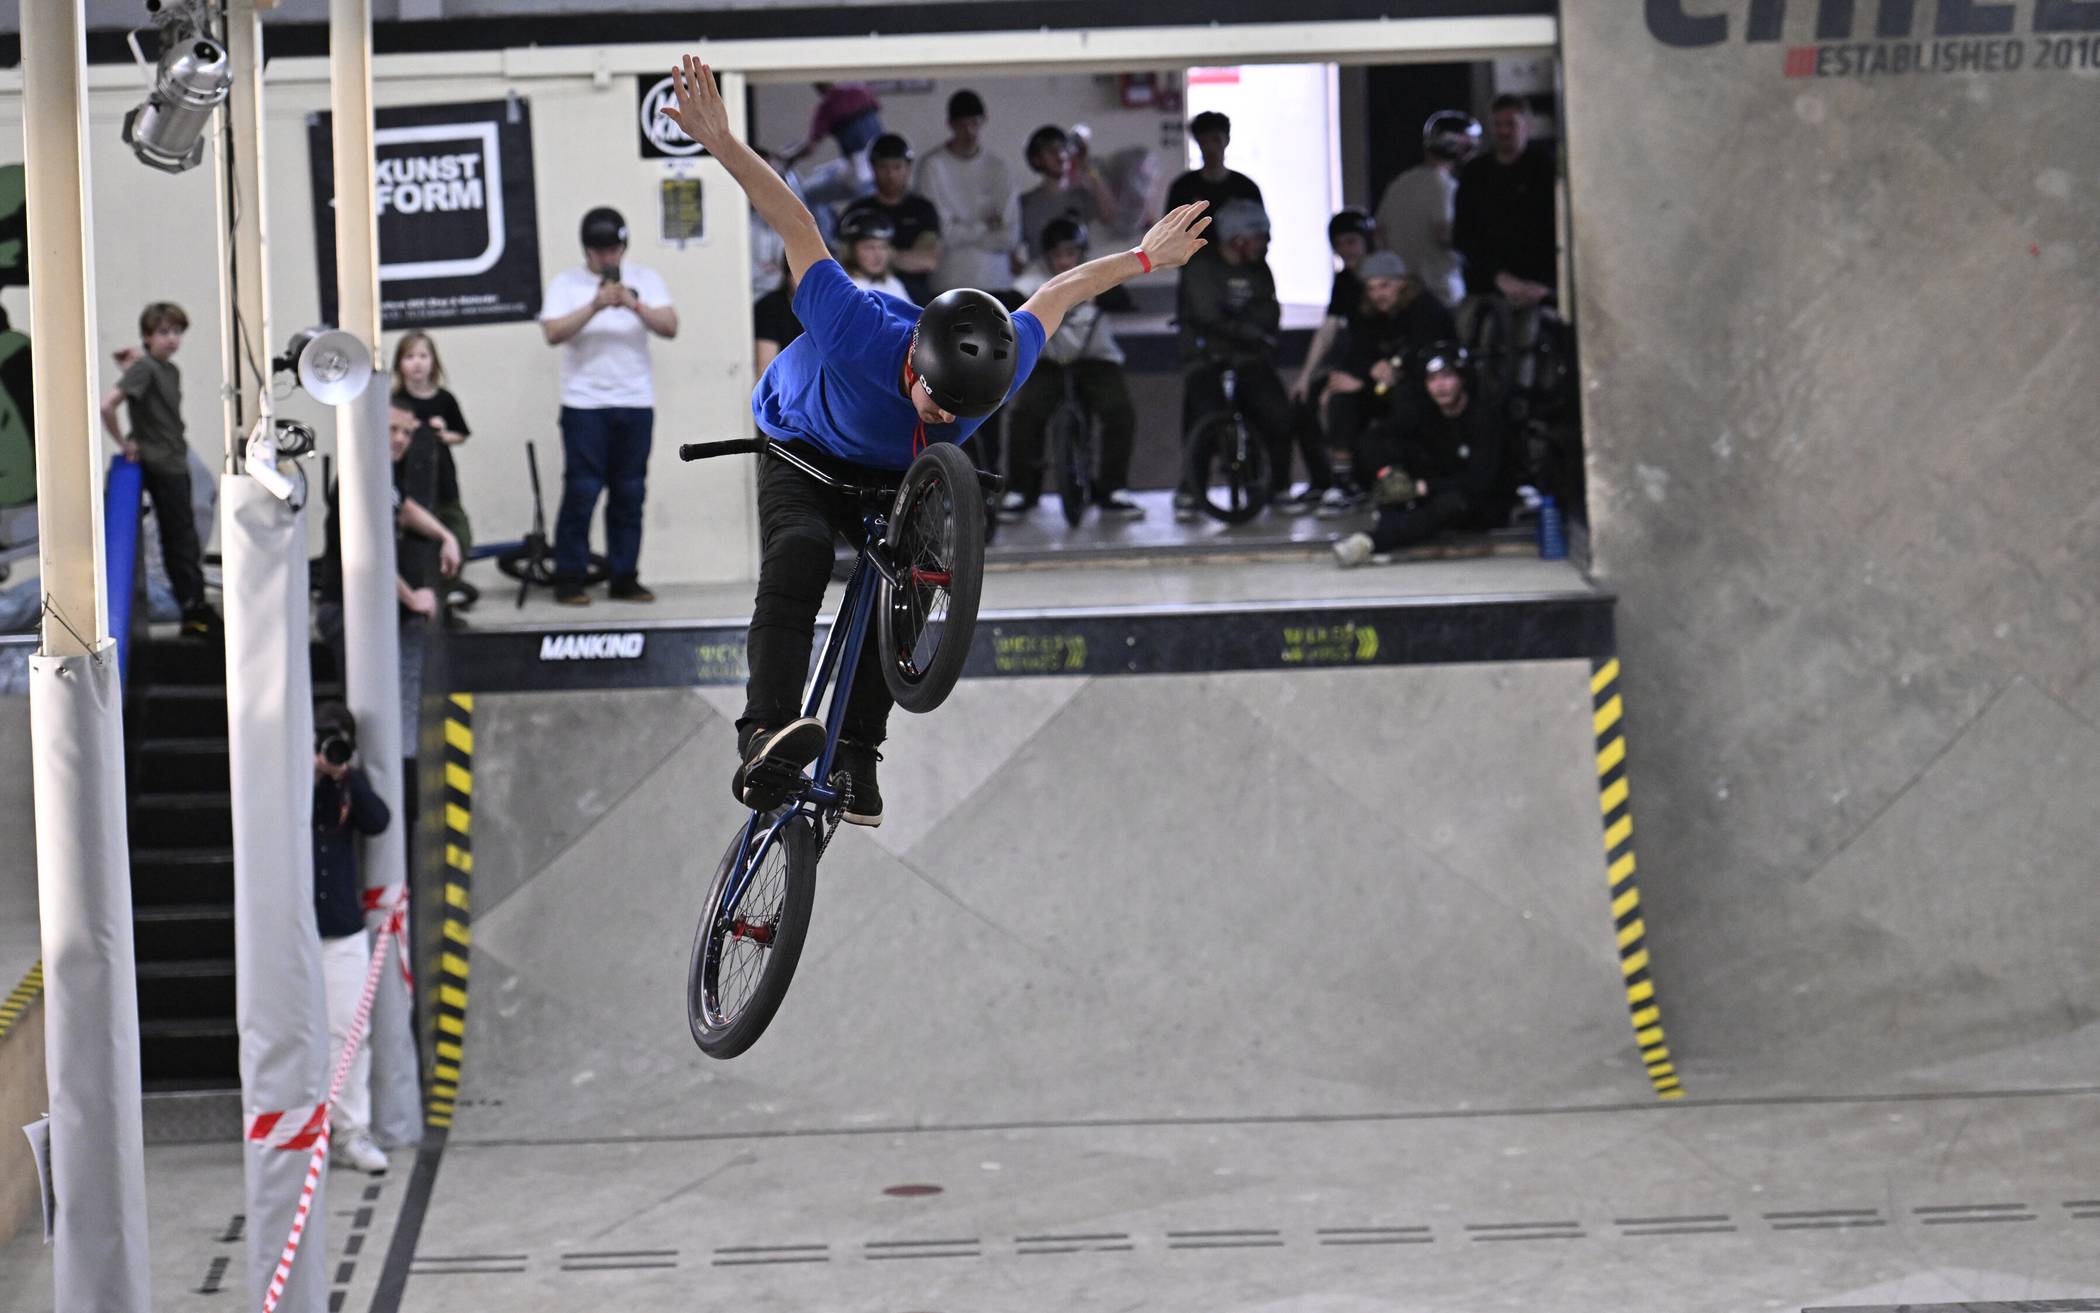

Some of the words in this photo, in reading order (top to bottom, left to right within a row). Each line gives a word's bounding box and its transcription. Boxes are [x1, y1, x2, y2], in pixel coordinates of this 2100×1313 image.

[1816, 38, 2023, 77] ESTABLISHED
[376, 153, 480, 185] KUNST
[376, 178, 483, 215] FORM
[540, 632, 645, 660] MANKIND
